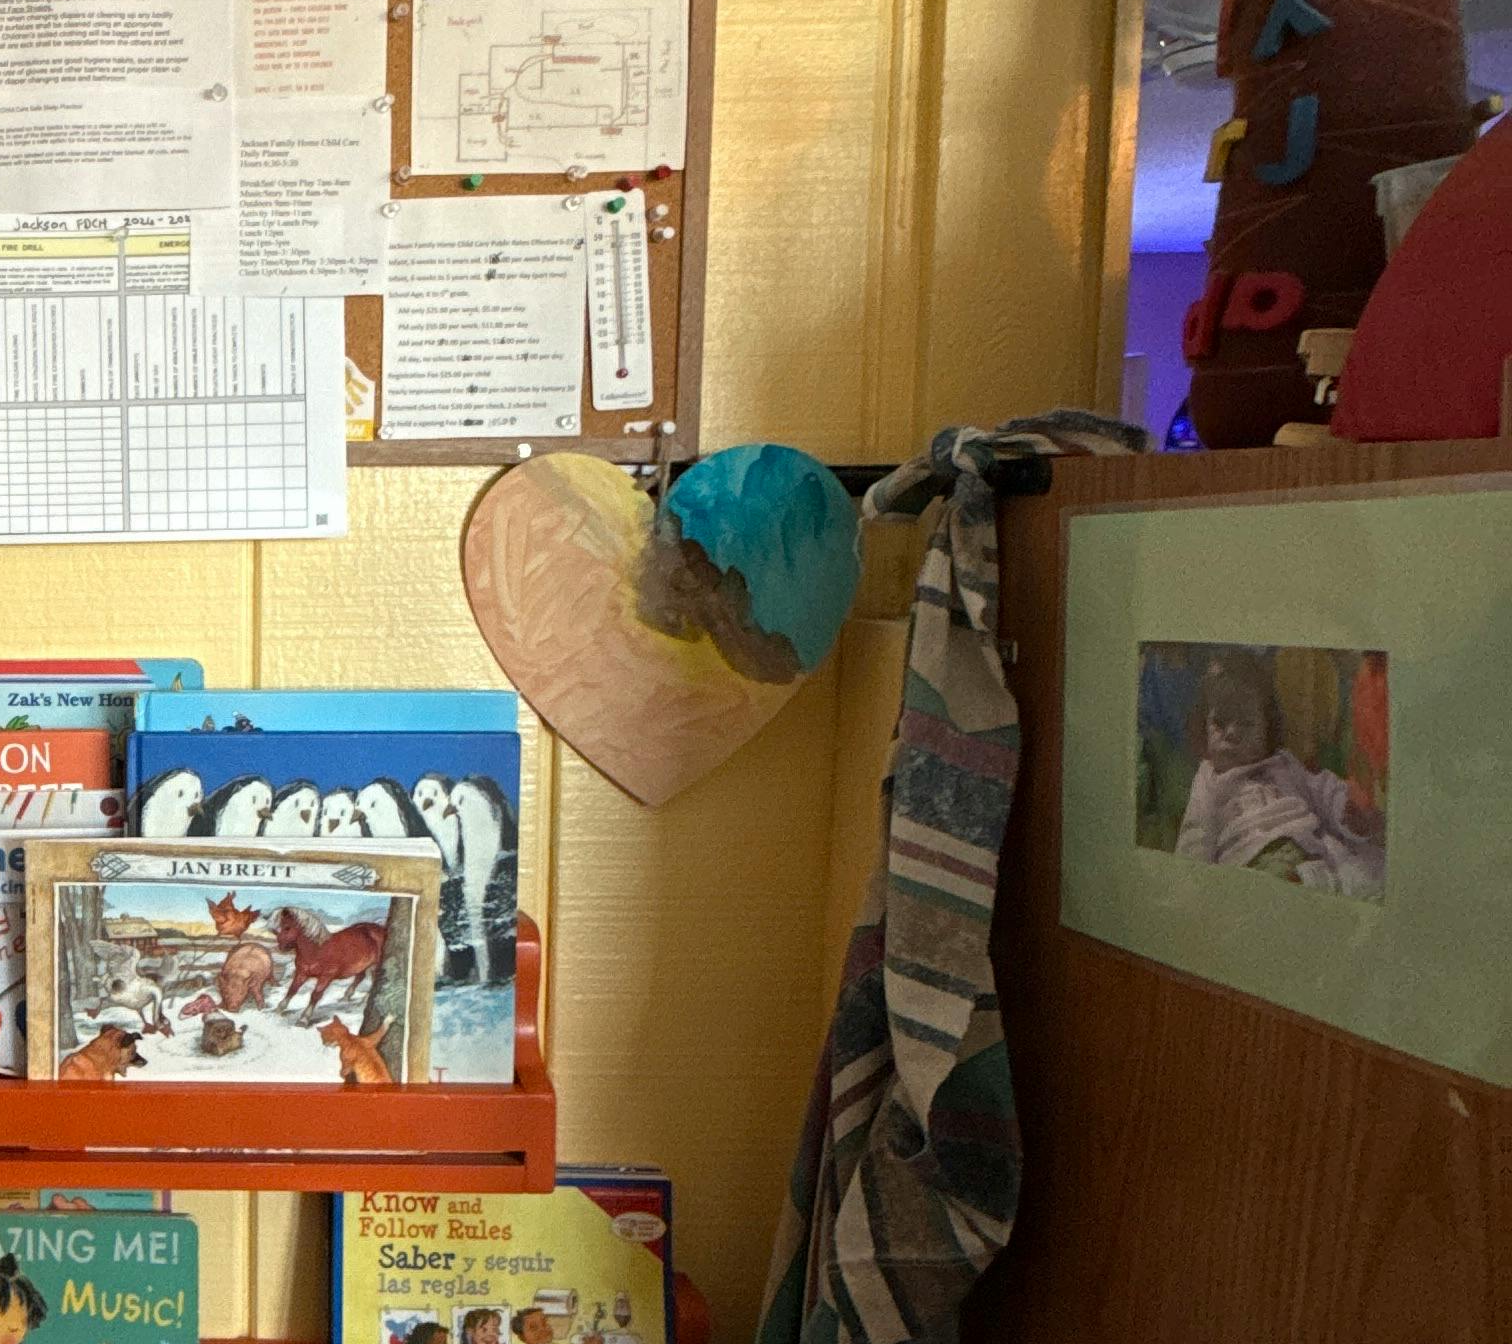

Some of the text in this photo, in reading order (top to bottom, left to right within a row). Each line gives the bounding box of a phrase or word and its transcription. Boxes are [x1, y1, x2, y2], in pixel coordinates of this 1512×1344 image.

[13, 217, 68, 231] Jackson
[7, 692, 52, 707] Zak's
[56, 692, 94, 707] New
[0, 742, 51, 774] ON
[167, 860, 296, 879] JAN BRETT
[359, 1190, 482, 1214] Know and
[359, 1217, 512, 1241] Follow Rules
[113, 1231, 179, 1265] ME!
[379, 1244, 554, 1275] Saber y seguir
[378, 1273, 489, 1297] las reglas
